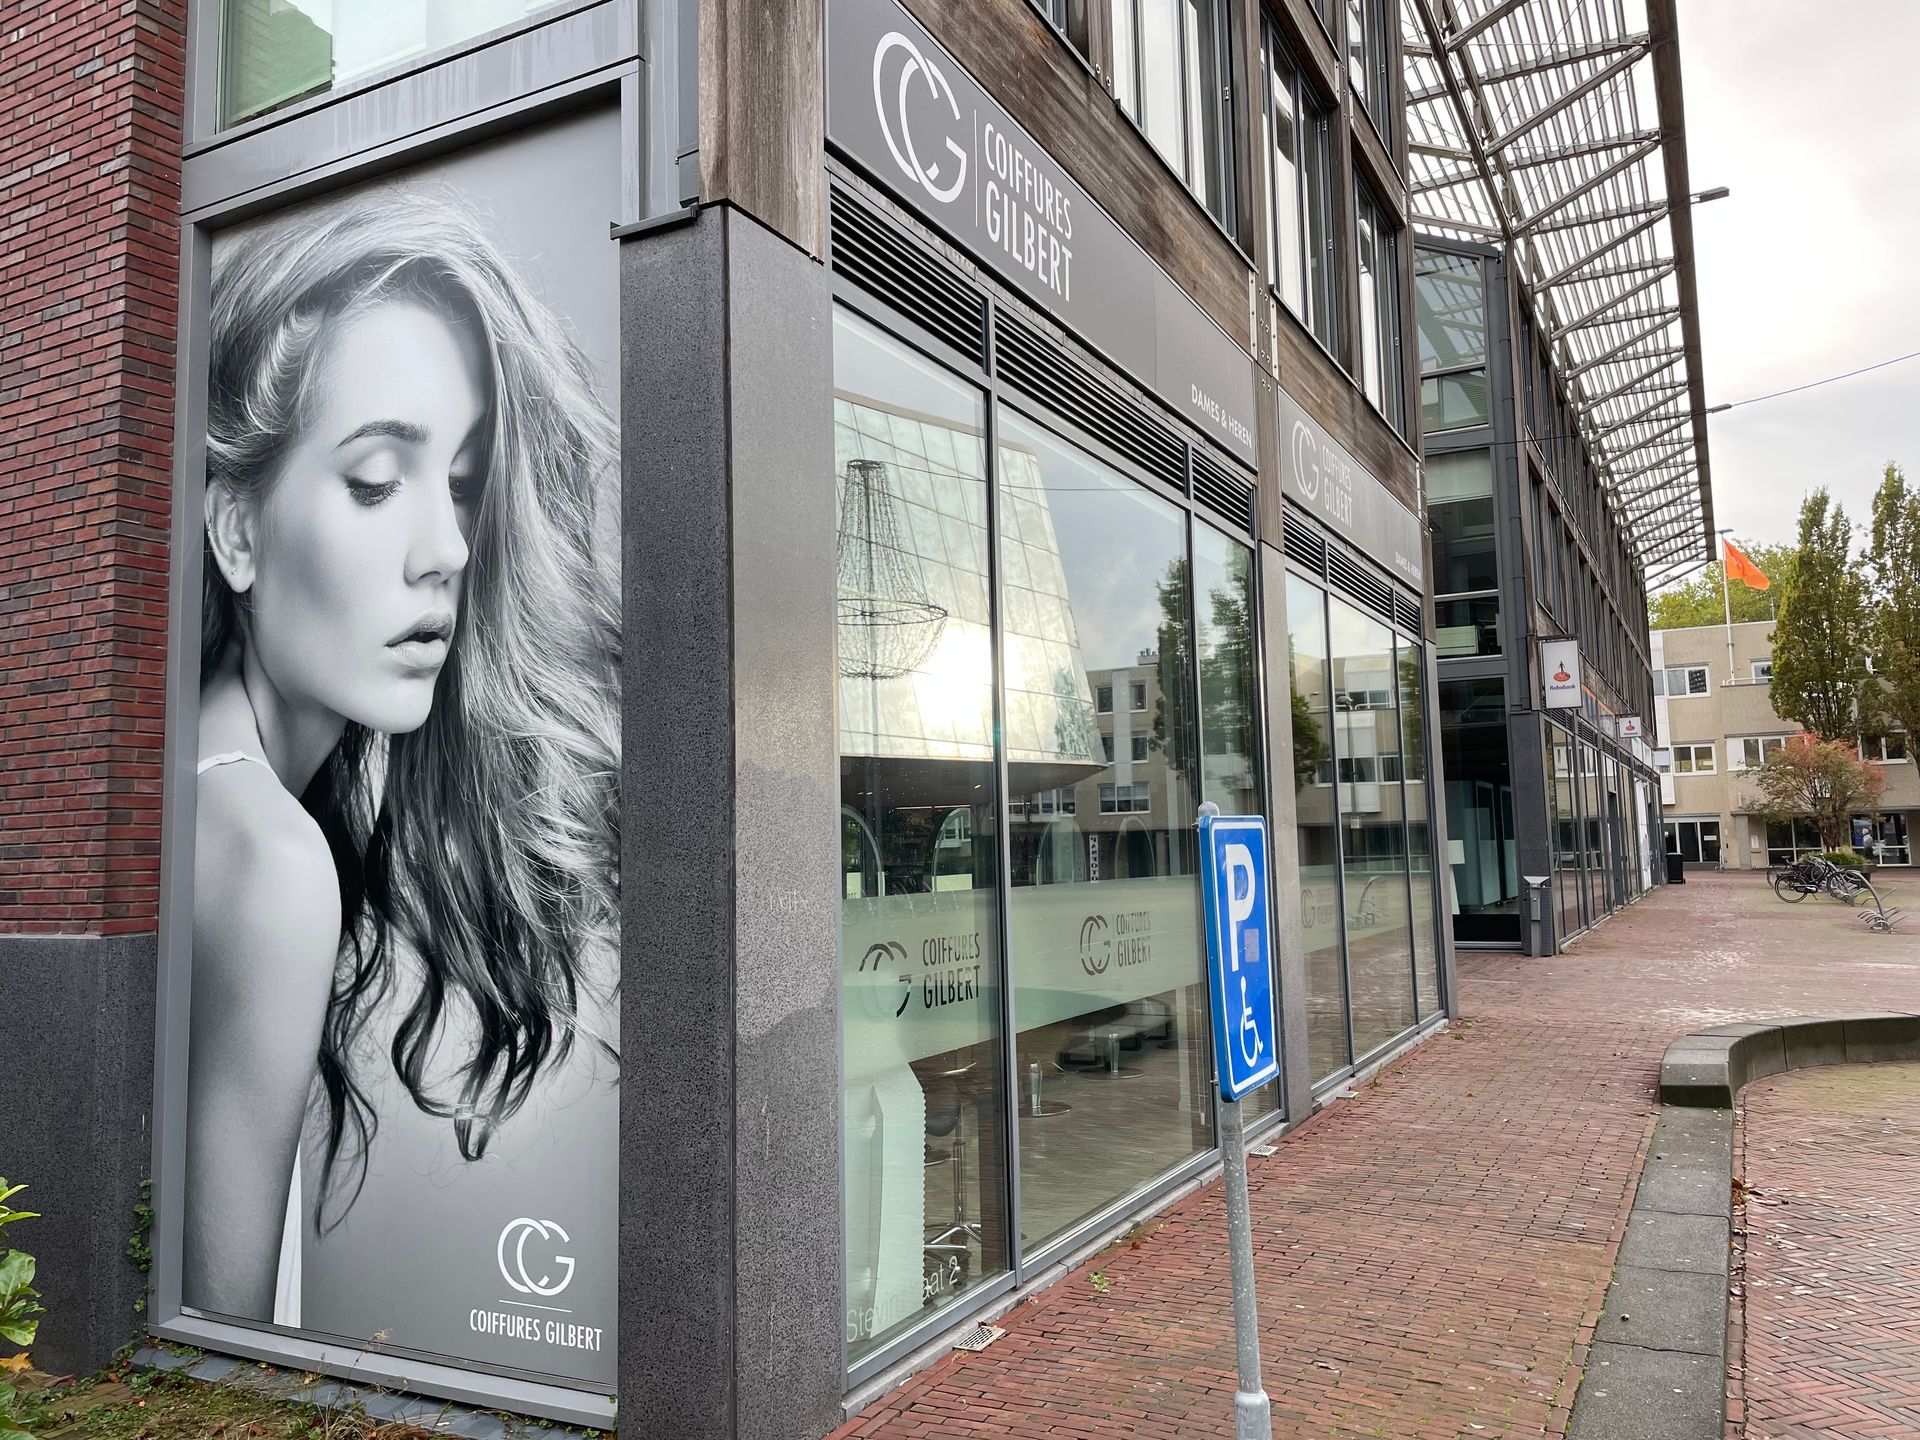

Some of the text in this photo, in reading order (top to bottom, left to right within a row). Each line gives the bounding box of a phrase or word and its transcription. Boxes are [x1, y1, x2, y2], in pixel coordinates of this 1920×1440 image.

[984, 122, 1072, 240] COIFFURES
[985, 180, 1073, 302] GILBERT
[1191, 383, 1252, 449] DAMES & HEREN
[1322, 445, 1352, 492] COIFFURES
[1324, 477, 1352, 528] GILBERT
[1225, 843, 1256, 972] P
[922, 932, 980, 967] COIFFURES
[1117, 935, 1152, 968] GILBERT
[923, 965, 980, 1010] GILBERT
[949, 1255, 959, 1286] 2
[469, 1309, 603, 1352] COIFFURES GILBERT
